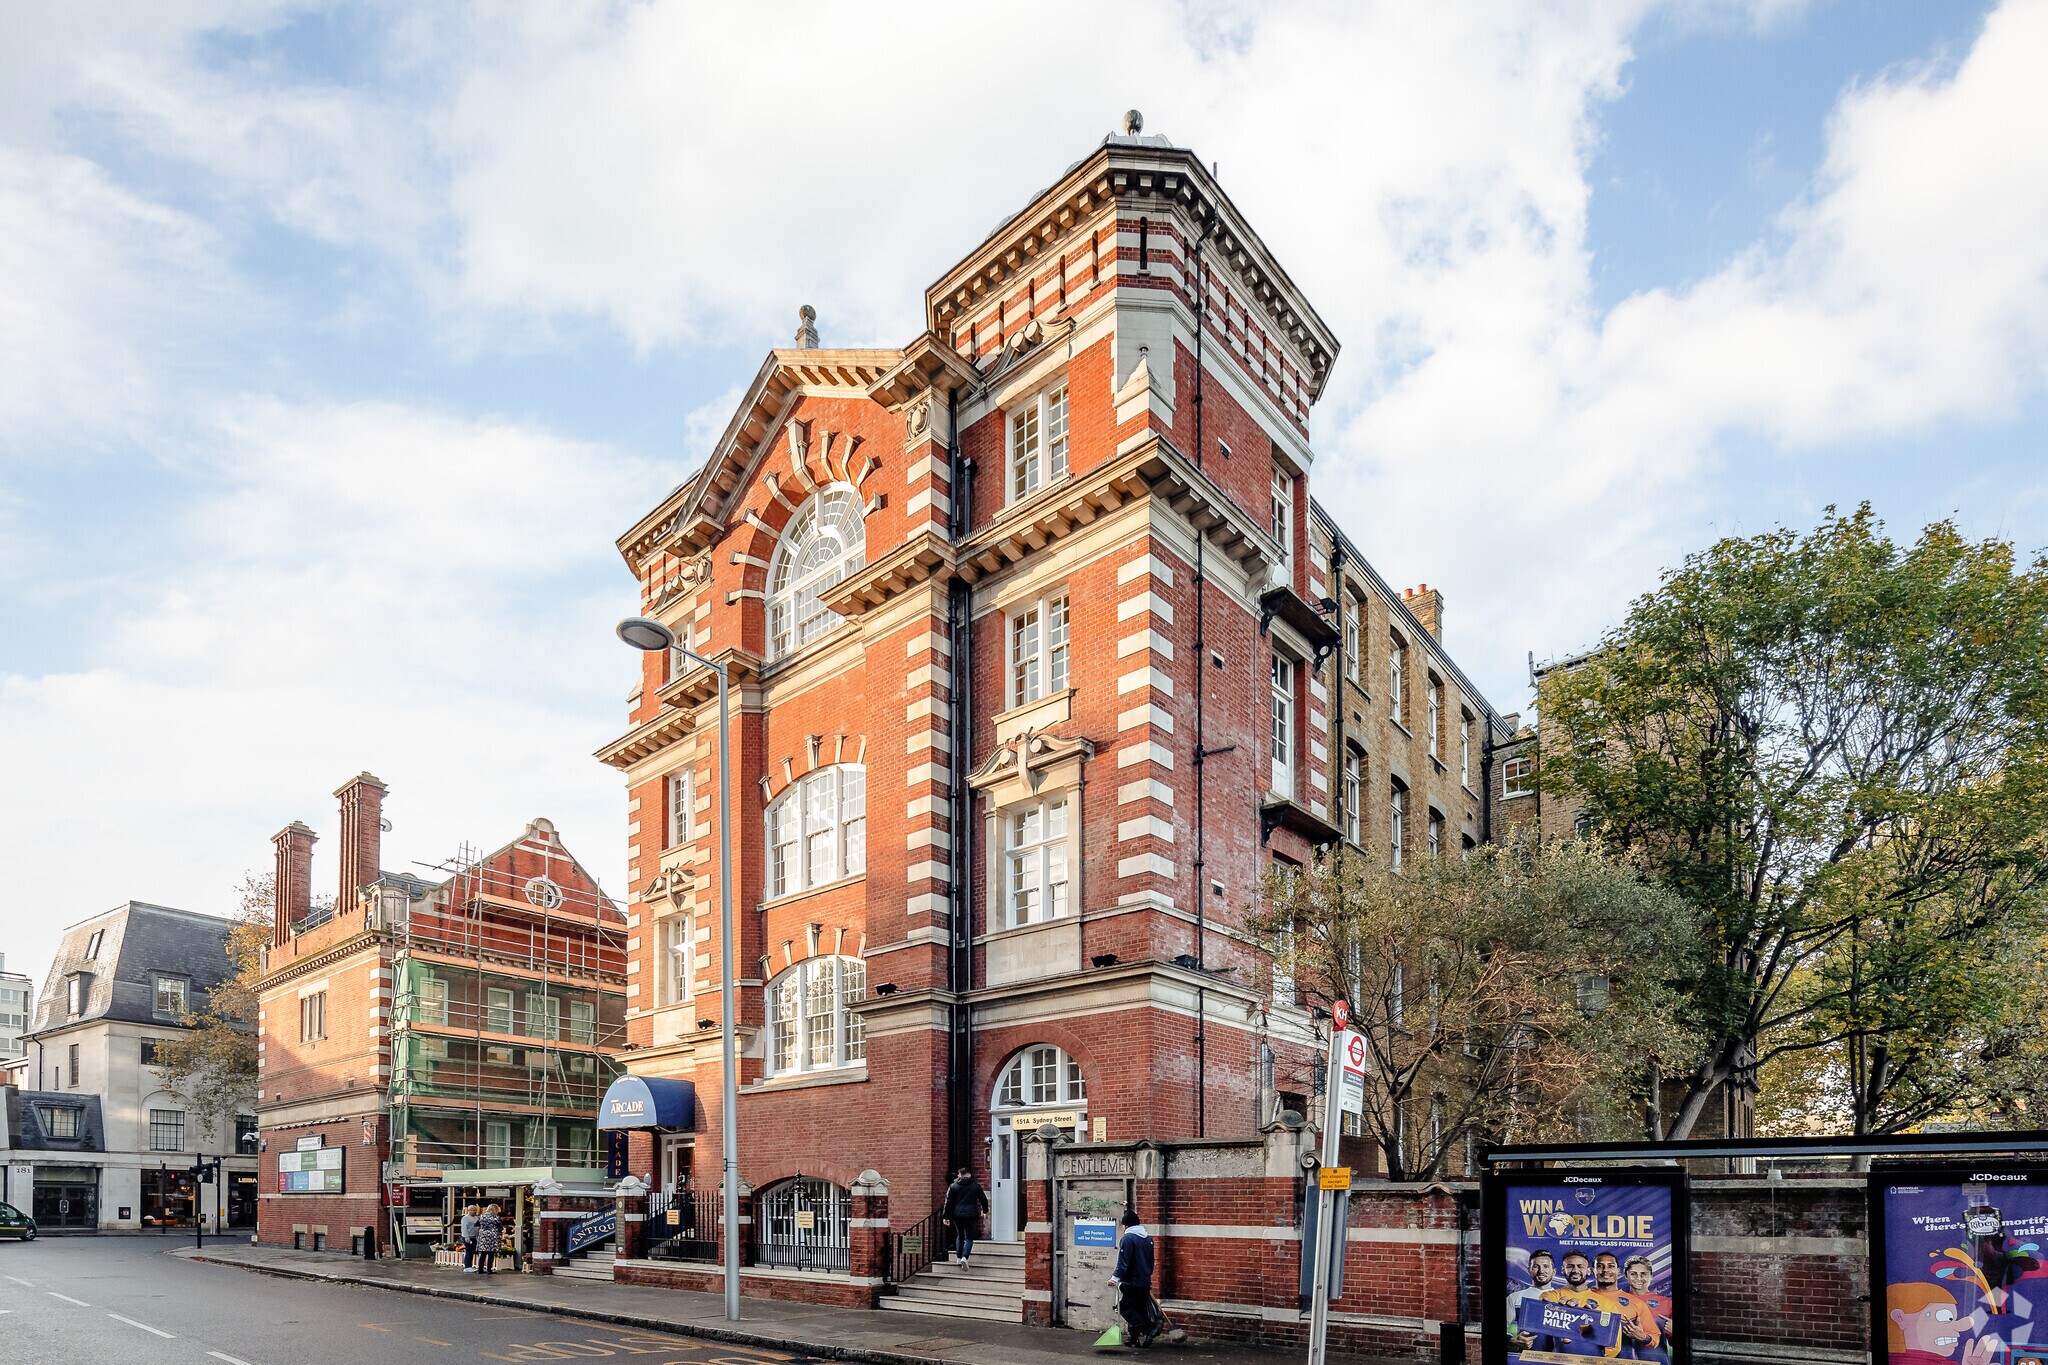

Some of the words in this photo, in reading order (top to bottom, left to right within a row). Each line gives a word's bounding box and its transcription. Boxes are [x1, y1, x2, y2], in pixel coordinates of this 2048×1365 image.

[1336, 1006, 1348, 1020] KH
[610, 1100, 644, 1114] ARCADE
[1033, 1117, 1053, 1125] Sydney
[1062, 1158, 1135, 1174] GENTLEMEN
[1969, 1173, 2028, 1181] JCDecaux
[1519, 1199, 1553, 1214] WIN
[1554, 1199, 1565, 1211] A
[1911, 1216, 1951, 1225] When
[1924, 1222, 1966, 1232] there's
[1970, 1220, 1999, 1230] Ribena
[1543, 1309, 1580, 1323] DAIRY
[1542, 1317, 1571, 1330] MILK
